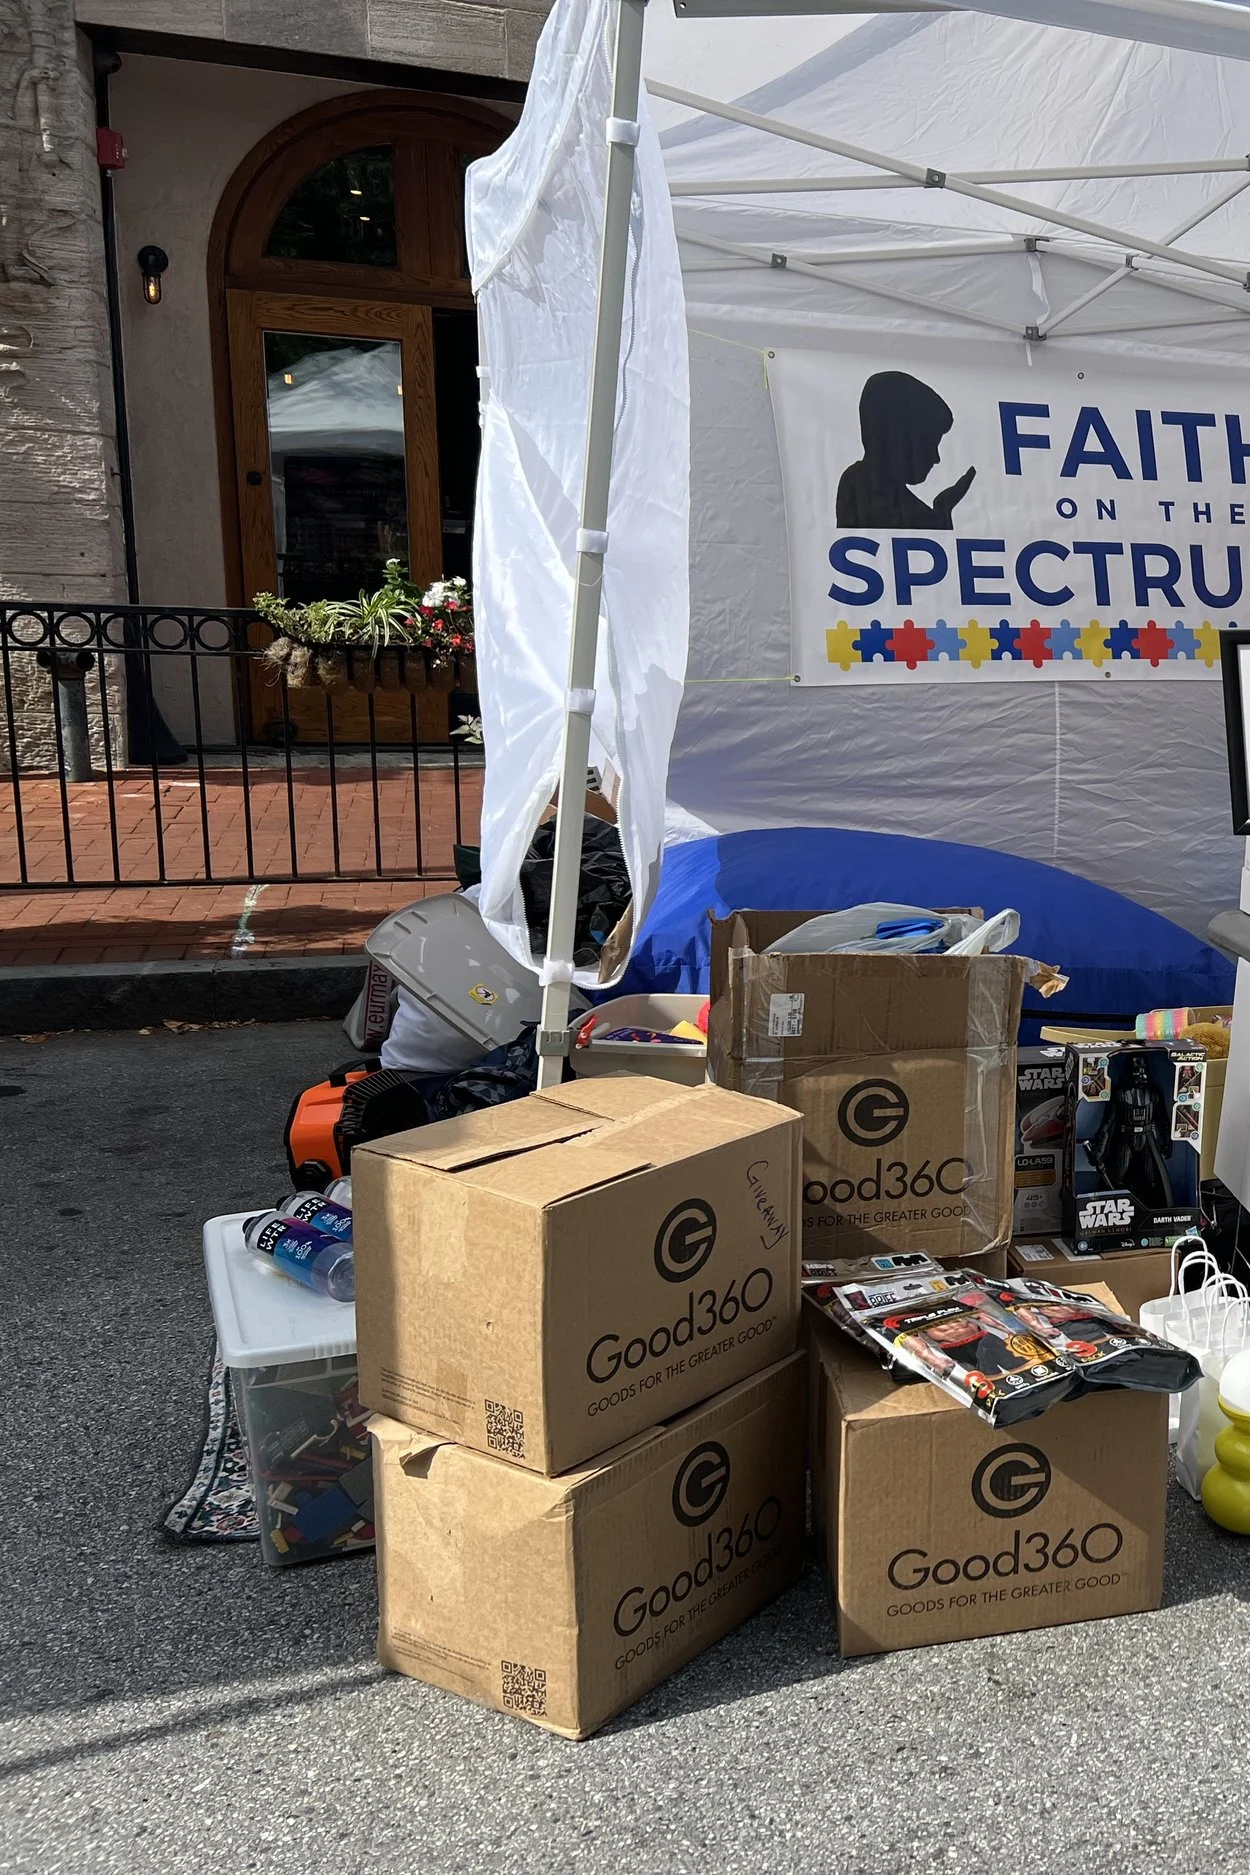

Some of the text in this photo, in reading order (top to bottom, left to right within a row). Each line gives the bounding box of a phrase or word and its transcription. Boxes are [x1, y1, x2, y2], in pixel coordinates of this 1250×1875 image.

[1056, 497, 1246, 525] ON THE
[1018, 1067, 1065, 1080] STAR
[1018, 1078, 1065, 1091] WARS
[295, 1198, 320, 1219] LIFE
[818, 1215, 843, 1228] FOR
[848, 1213, 870, 1224] THE
[874, 1209, 927, 1223] GREATER
[931, 1205, 972, 1219] GOOD
[1079, 1198, 1134, 1215] STAR
[1079, 1211, 1134, 1229] WARS
[260, 1222, 281, 1248] LIFE
[266, 1225, 287, 1250] WTR
[586, 1267, 773, 1384] Good360
[587, 1383, 636, 1417] GOODS
[639, 1371, 663, 1393] FOR
[665, 1361, 685, 1380] THE
[688, 1337, 735, 1369] GREATER
[613, 1496, 781, 1637] Good360
[888, 1522, 1123, 1591] Good360
[887, 1598, 945, 1617] GOODS
[949, 1594, 977, 1609] FOR
[981, 1590, 1007, 1603] THE
[1010, 1581, 1071, 1600] GREATER
[615, 1631, 661, 1671] GOODS
[663, 1615, 686, 1639] FOR
[687, 1600, 707, 1621] THE
[708, 1570, 750, 1612] GREATER
